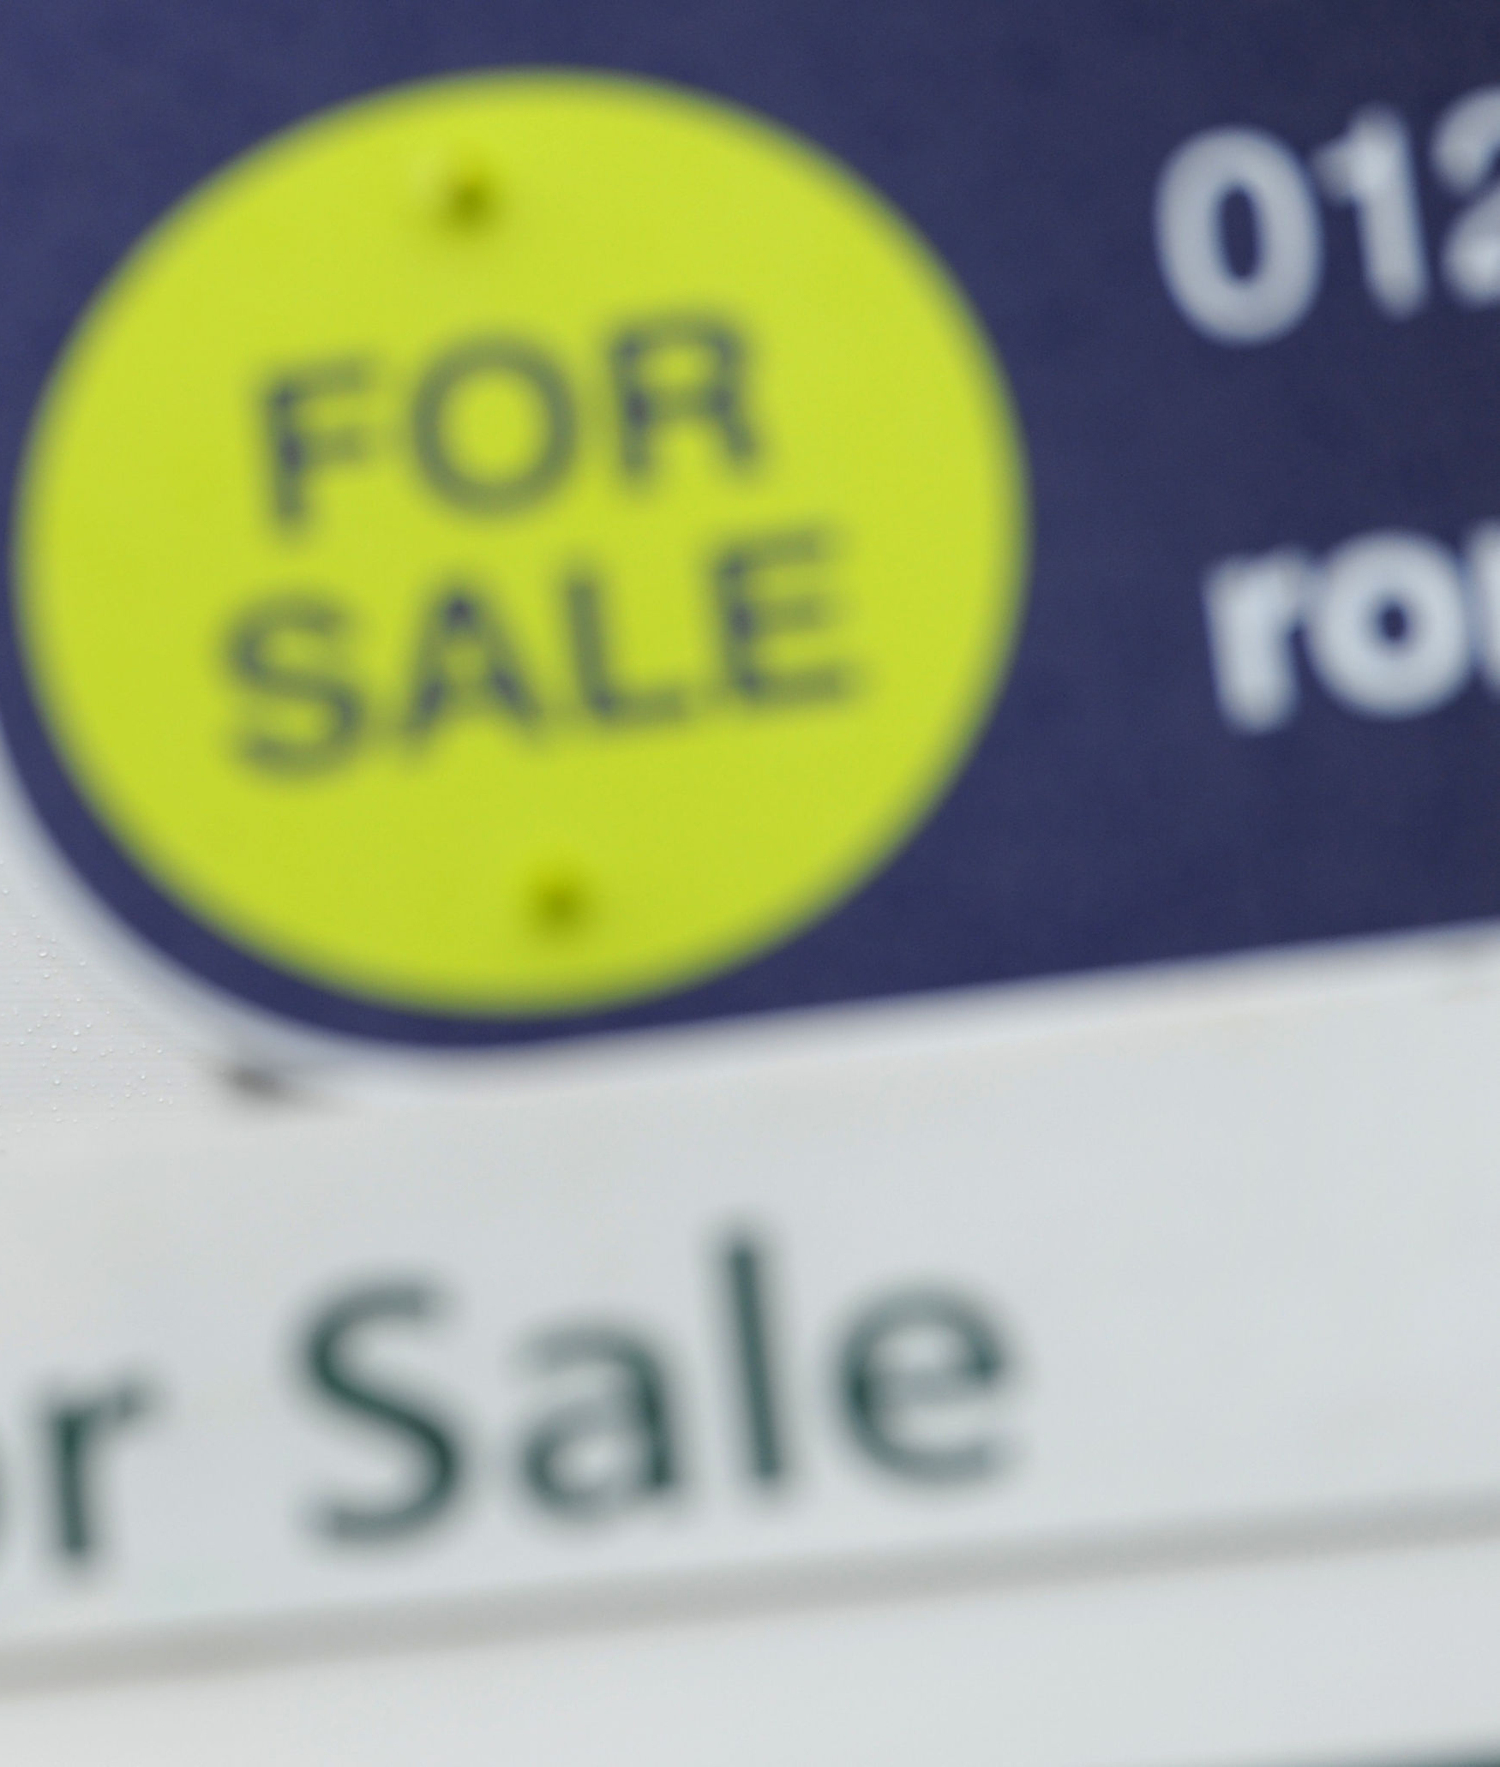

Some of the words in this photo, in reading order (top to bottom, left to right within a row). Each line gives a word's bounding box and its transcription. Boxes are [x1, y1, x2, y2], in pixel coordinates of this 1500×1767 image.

[260, 307, 763, 540] FOR
[218, 528, 856, 780] SALE
[1207, 520, 1500, 732] ro
[296, 1230, 1012, 1546] Sale
